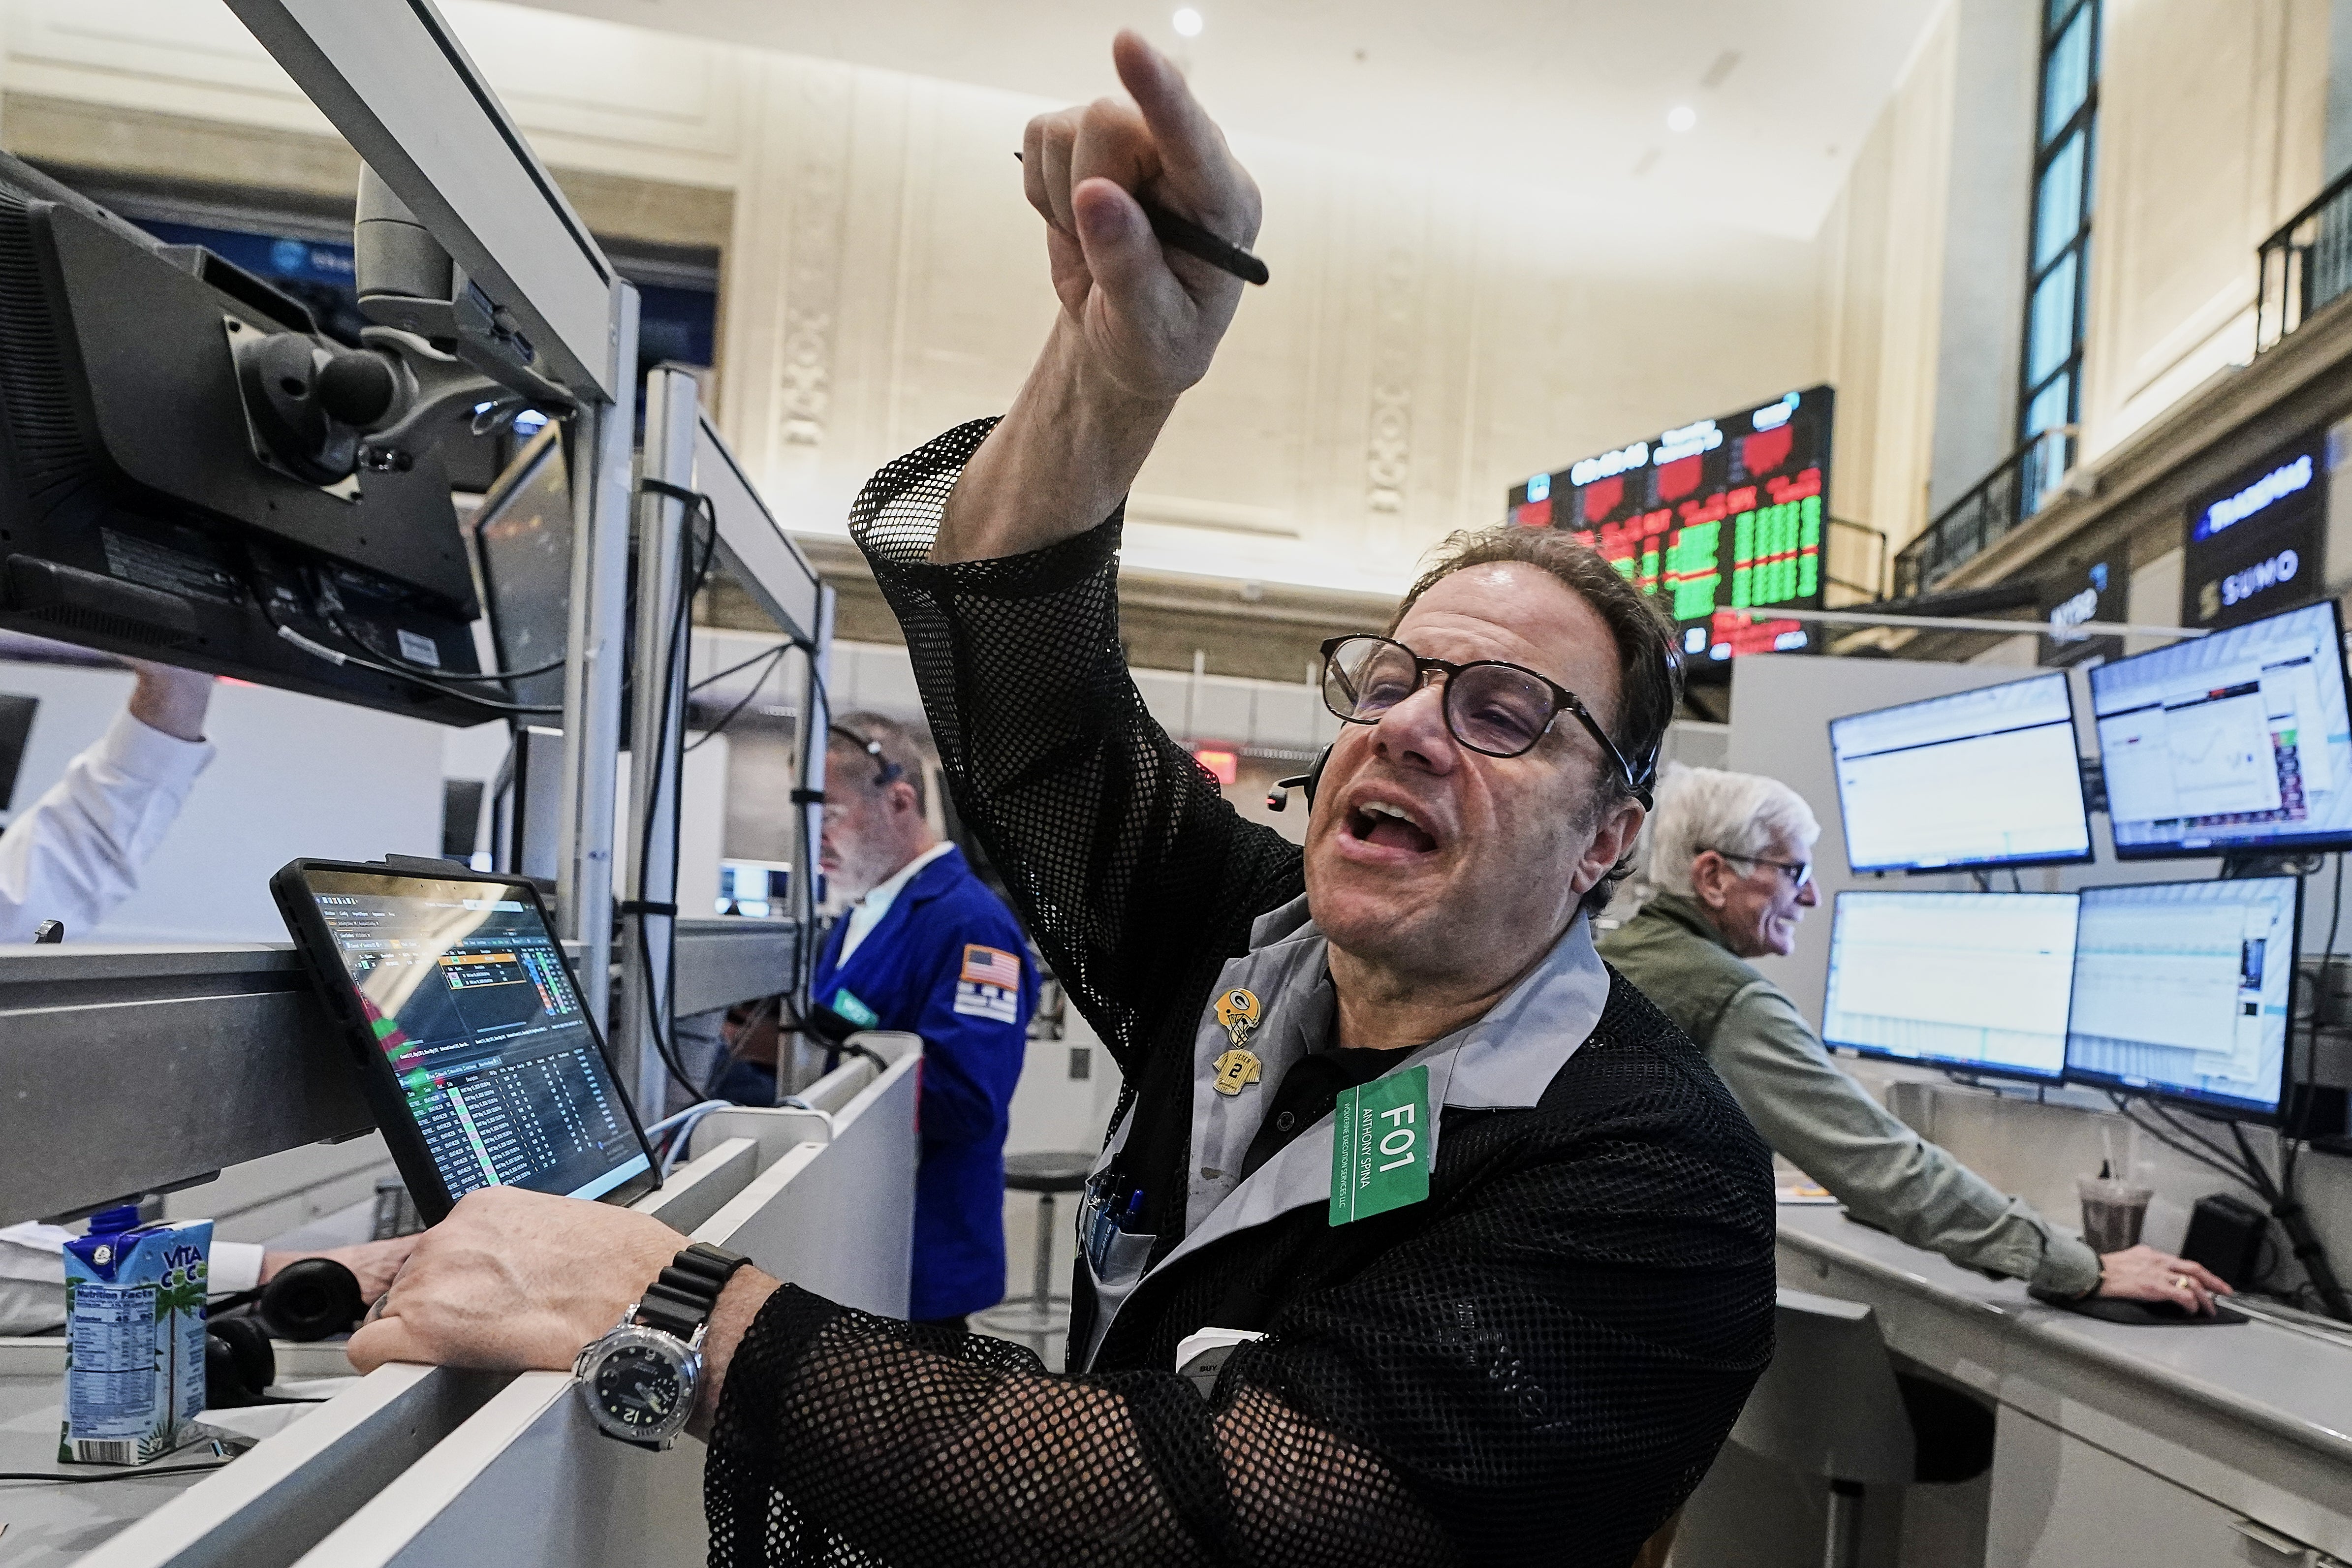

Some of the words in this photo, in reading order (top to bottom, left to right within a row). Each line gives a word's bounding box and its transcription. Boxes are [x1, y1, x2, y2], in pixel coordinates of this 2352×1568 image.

[1230, 992, 1250, 1010] G
[1234, 1054, 1251, 1064] JETER
[1228, 1064, 1242, 1078] 2
[1361, 1109, 1373, 1155] ANTHONY
[1360, 1158, 1371, 1189] SPINA
[164, 1245, 202, 1269] VITA
[161, 1262, 208, 1287] COCO
[623, 1408, 640, 1424] 12
